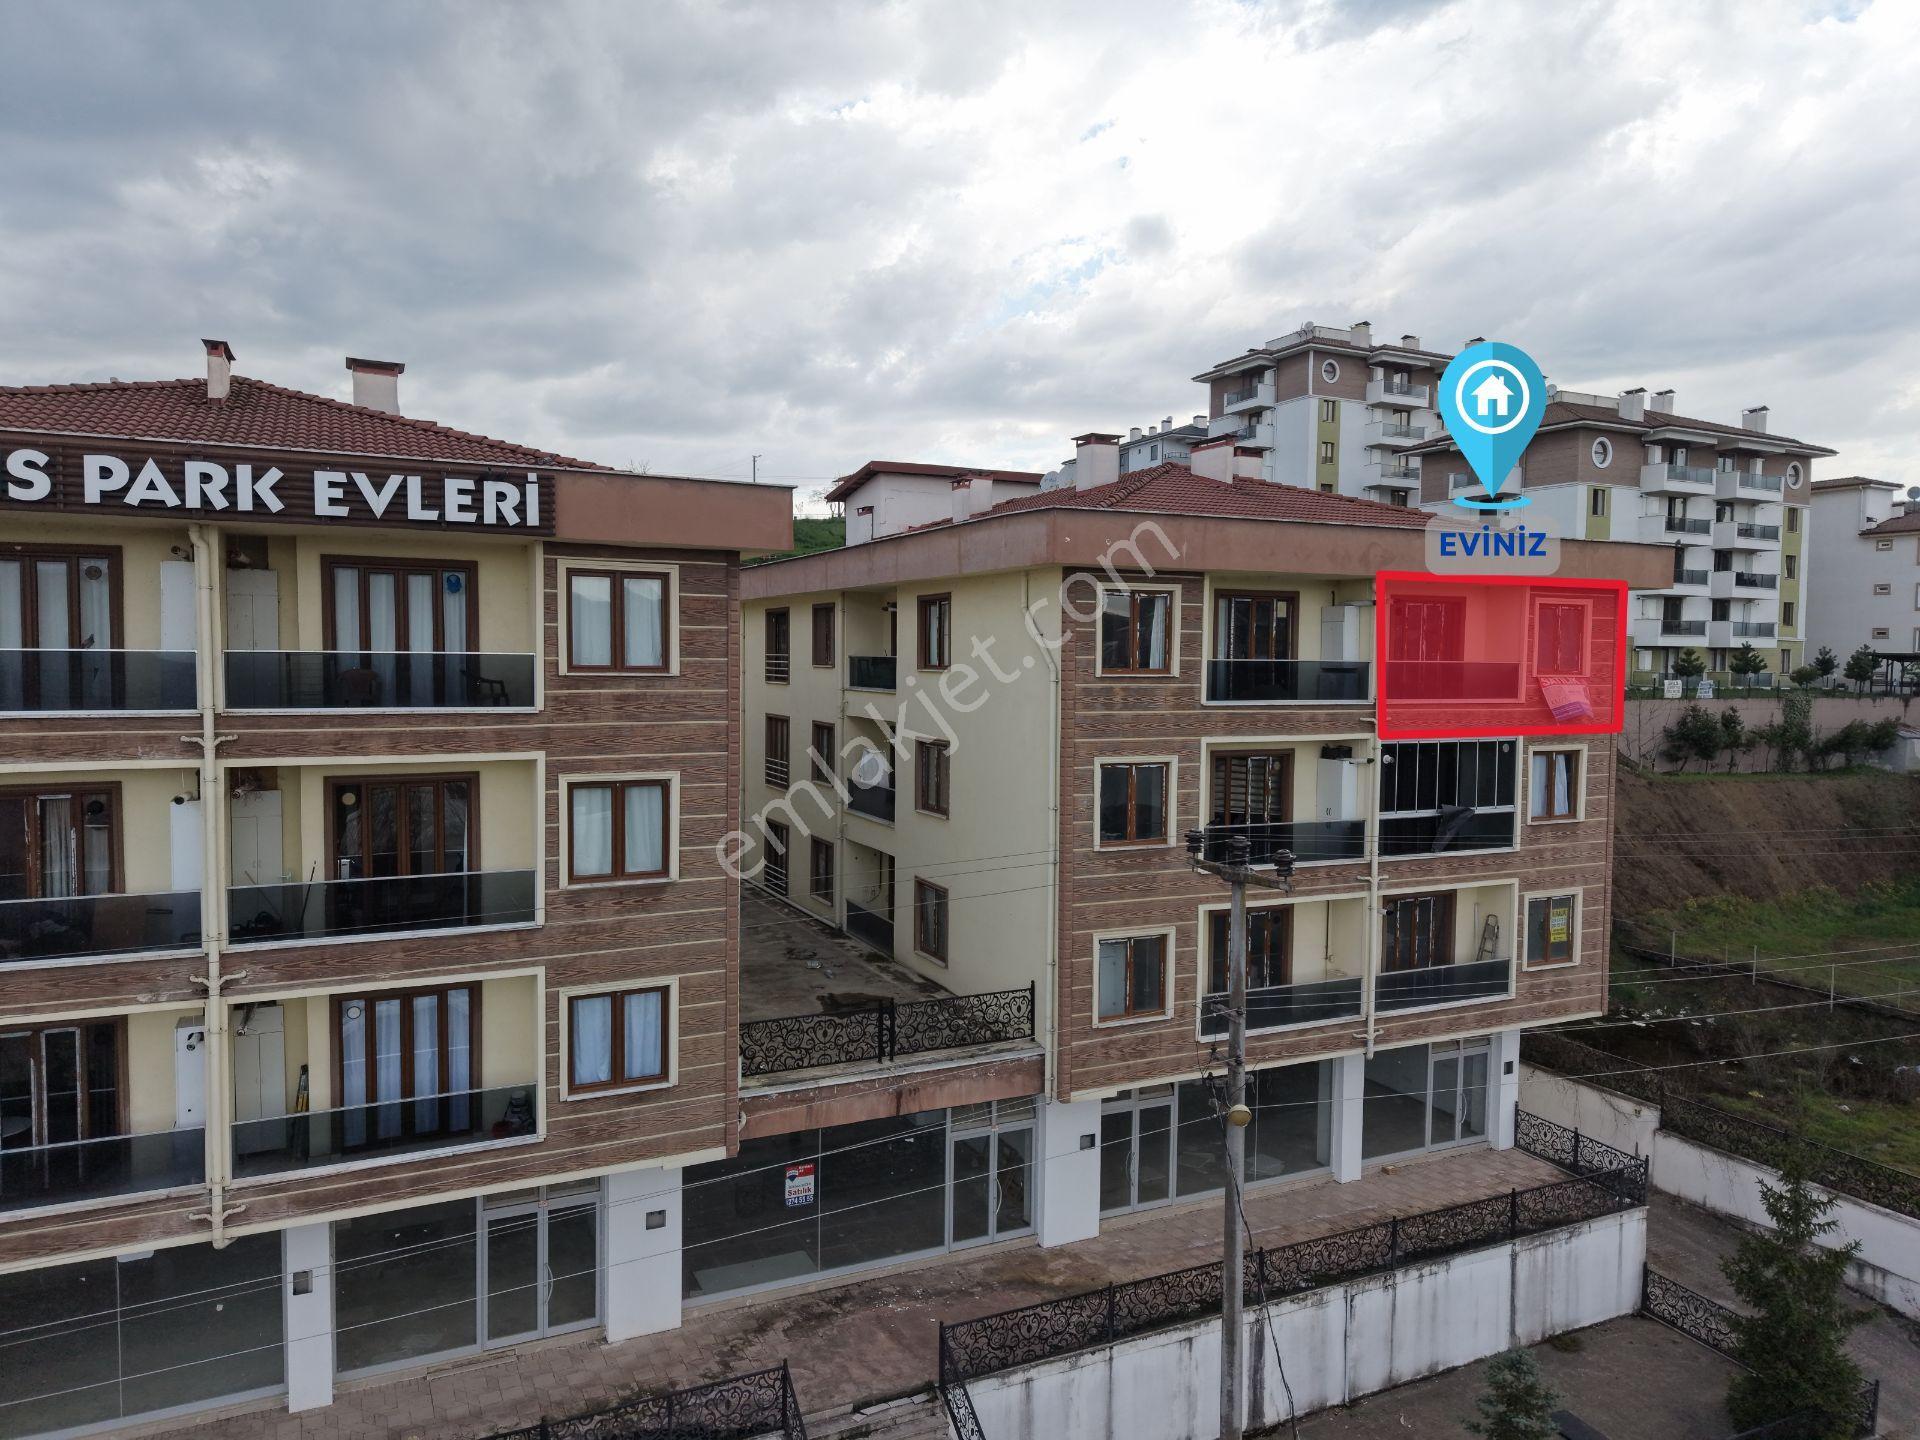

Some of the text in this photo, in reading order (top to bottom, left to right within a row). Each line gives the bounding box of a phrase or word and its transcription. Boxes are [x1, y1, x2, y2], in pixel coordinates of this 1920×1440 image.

[6, 448, 540, 527] S PARK EVLERİ
[787, 1186, 812, 1197] Satılık
